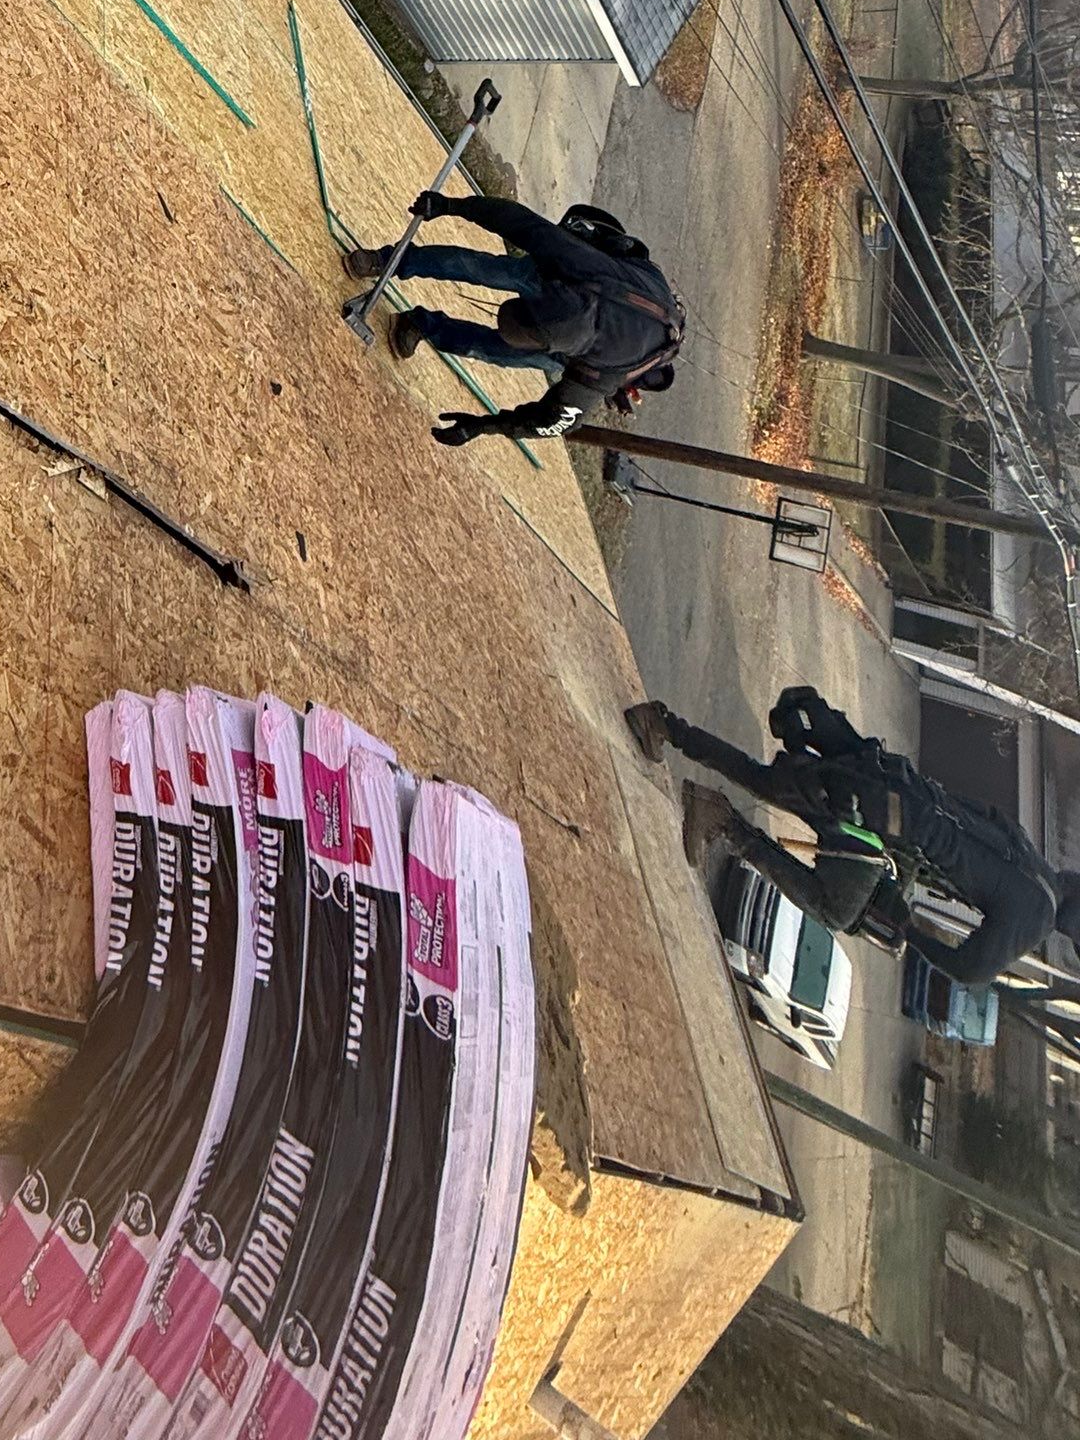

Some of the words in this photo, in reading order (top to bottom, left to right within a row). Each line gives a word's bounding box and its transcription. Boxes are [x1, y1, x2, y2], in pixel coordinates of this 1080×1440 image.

[237, 766, 255, 831] MORE
[106, 822, 135, 971] DURATION
[420, 928, 430, 958] TOTAL
[436, 996, 452, 1011] 3
[230, 1127, 314, 1323] DURATION
[317, 1270, 397, 1440] URATION
